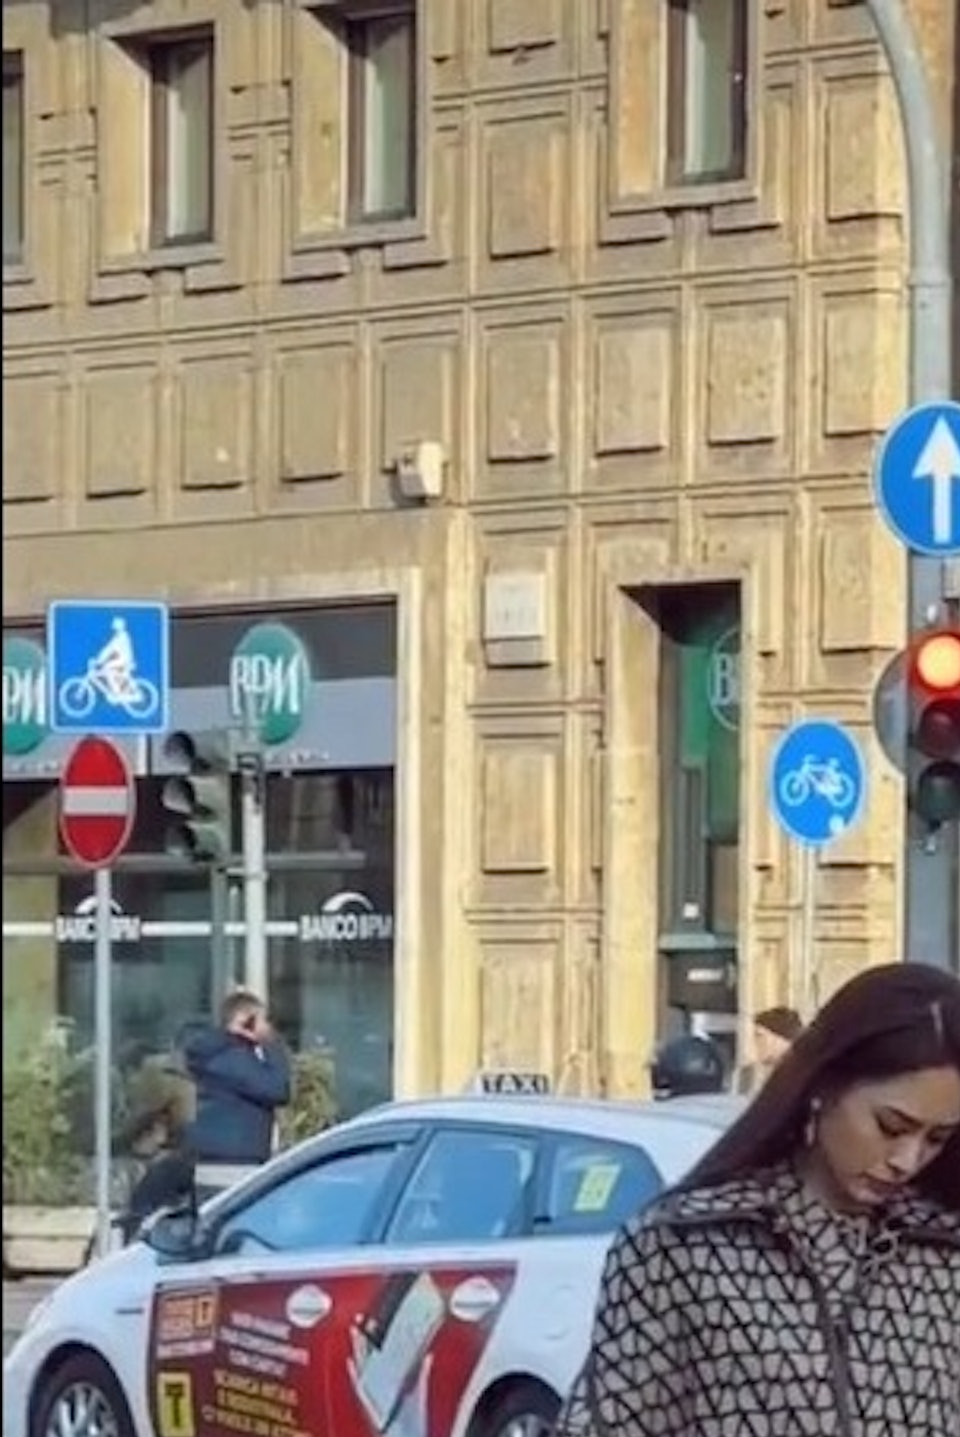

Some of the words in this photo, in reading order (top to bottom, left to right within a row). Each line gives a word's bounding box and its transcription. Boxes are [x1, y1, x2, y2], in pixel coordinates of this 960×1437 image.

[2, 666, 46, 725] PM
[300, 914, 358, 941] BANCO
[359, 914, 393, 941] BPM
[481, 1073, 550, 1094] TAXI
